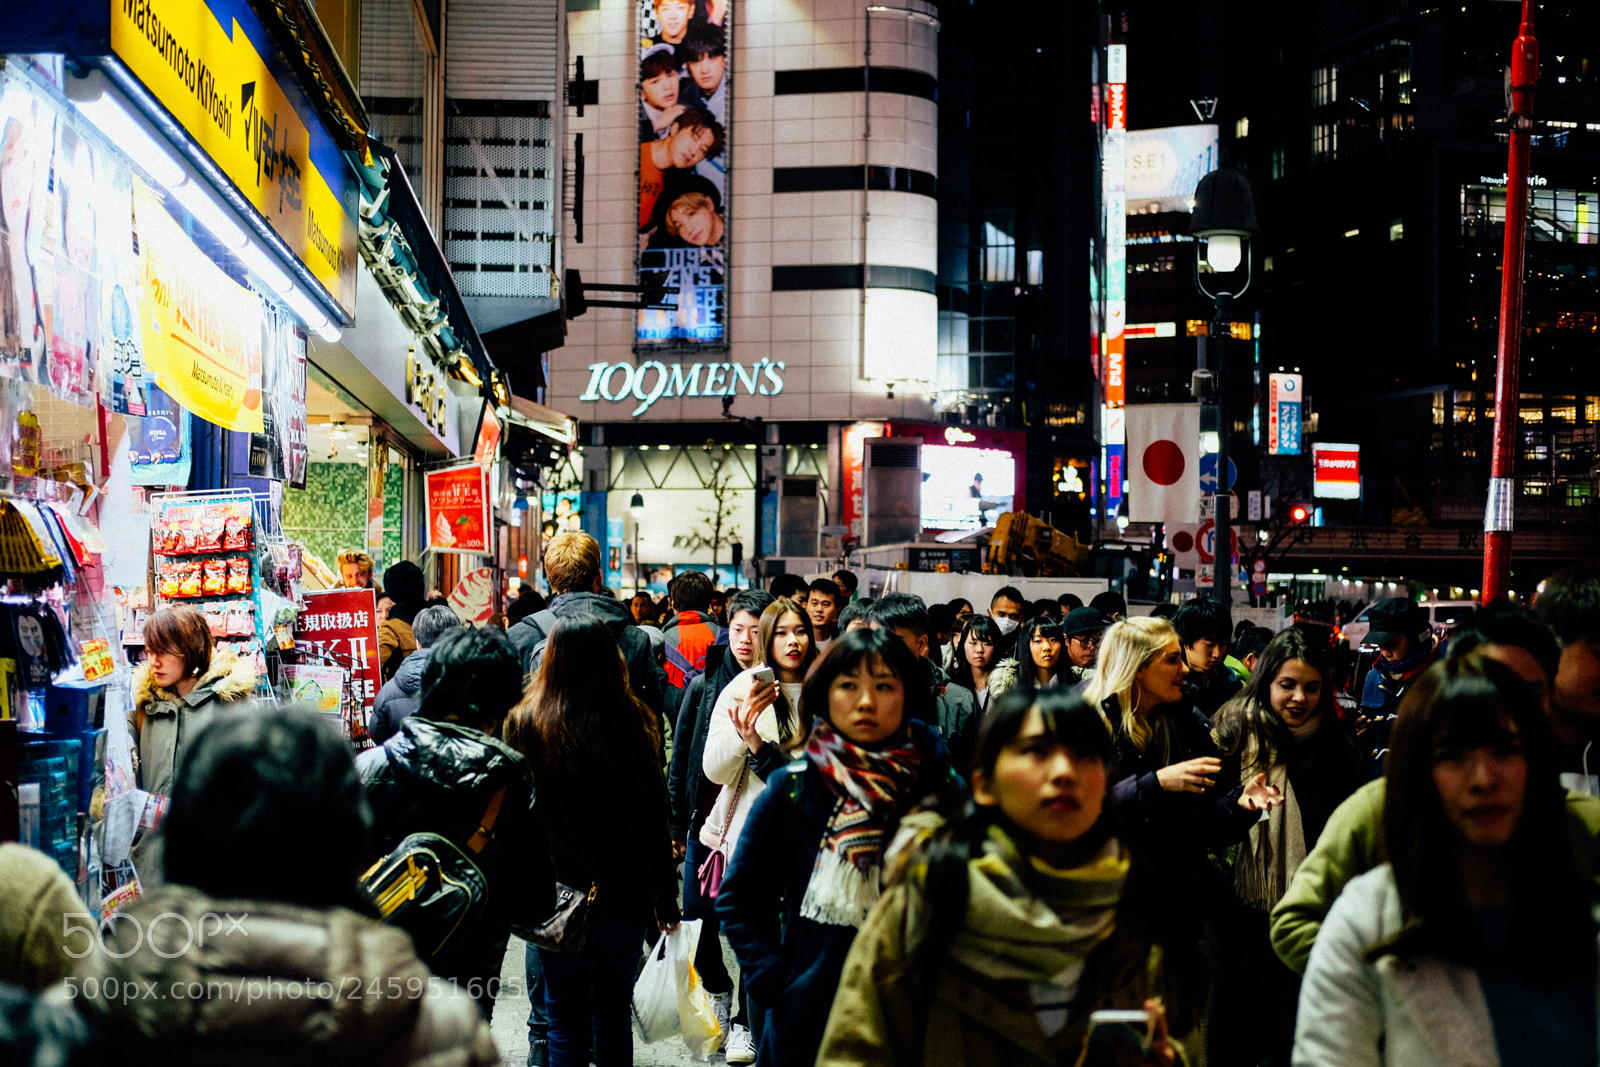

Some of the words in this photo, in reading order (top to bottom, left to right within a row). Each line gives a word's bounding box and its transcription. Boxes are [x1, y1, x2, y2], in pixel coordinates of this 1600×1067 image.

[196, 58, 233, 140] KiYoshi
[430, 496, 482, 505] ソフトクリーム
